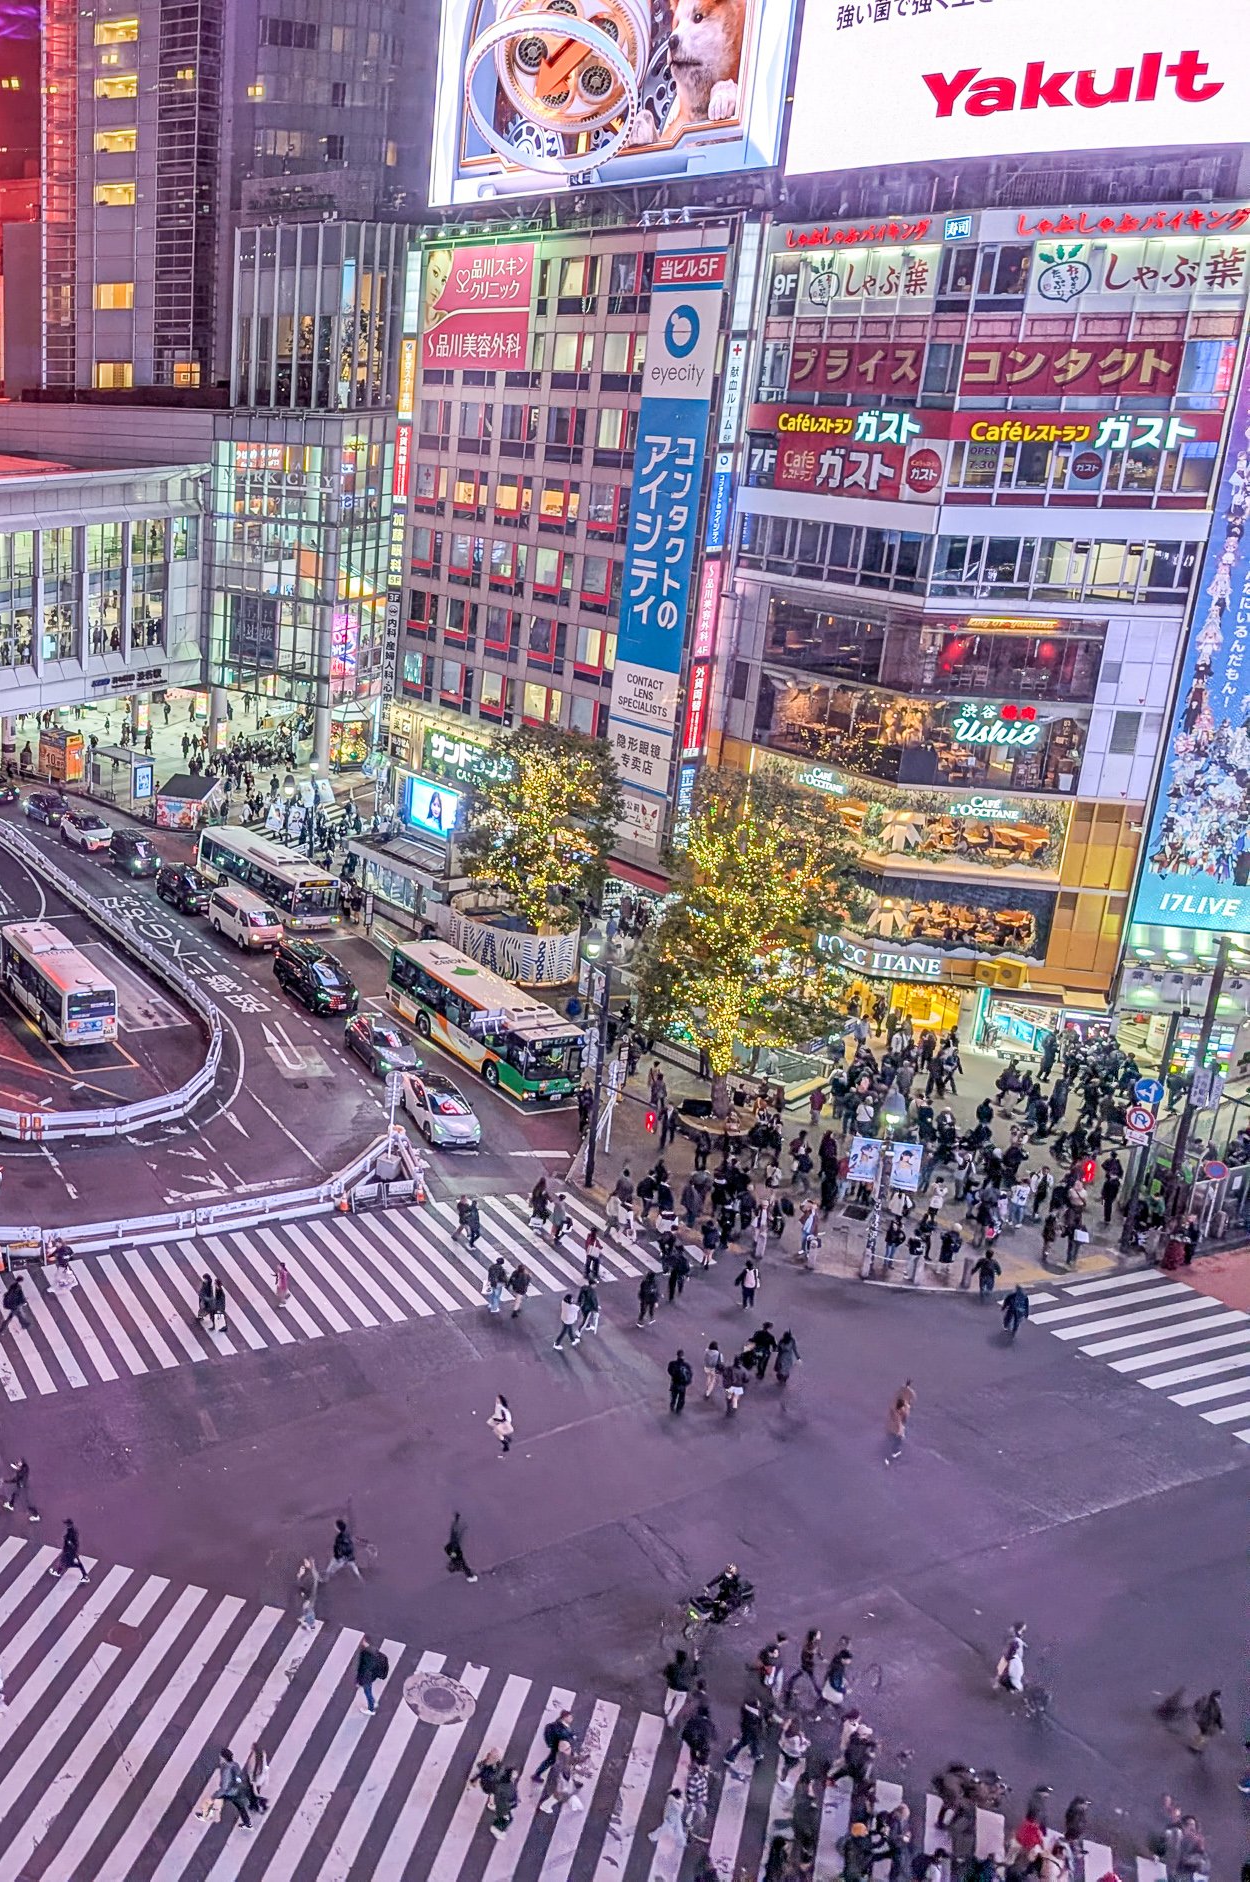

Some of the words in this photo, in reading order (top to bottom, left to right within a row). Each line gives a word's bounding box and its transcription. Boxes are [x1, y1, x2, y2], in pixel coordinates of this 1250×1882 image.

[921, 50, 1225, 118] Yakult
[786, 218, 932, 248] しゃぶしゃぶバイキング
[946, 219, 970, 236] 寿司
[1017, 208, 1250, 237] しゃぶしゃぶバイキング
[471, 256, 528, 279] 品川スキン
[660, 257, 719, 280] 当ビル5F
[845, 258, 929, 297] しゃぶ葉
[1105, 246, 1247, 290] しゃぶ葉
[469, 280, 520, 300] クリニック
[773, 273, 797, 296] 9F
[435, 332, 521, 359] 品川美容外科
[651, 363, 706, 387] eyecity
[793, 349, 919, 383] プライス
[963, 348, 1173, 385] コンタクト
[854, 409, 921, 444] ガスト
[1095, 415, 1197, 449] ガスト
[751, 448, 778, 472] 7F
[783, 450, 815, 469] Café
[971, 446, 998, 456] OPEN
[223, 468, 278, 484] MARK
[782, 468, 813, 481] レストラン
[816, 447, 895, 491] ガスト
[910, 467, 938, 481] ガスト
[1075, 463, 1099, 473] ガスト
[630, 435, 672, 625] アイシティ
[656, 437, 697, 630] コンタクトの
[389, 594, 399, 602] 3F
[697, 645, 708, 654] 4F
[626, 673, 664, 691] CONTACT
[633, 686, 654, 701] LENS
[617, 695, 668, 718] SPECIALISTS
[953, 717, 1041, 745] Ushi8
[616, 732, 661, 760] 隐形眼镜
[620, 752, 654, 776] 专卖店
[950, 803, 1020, 820] L'OCCITANE
[1159, 893, 1242, 917] 17LIVE
